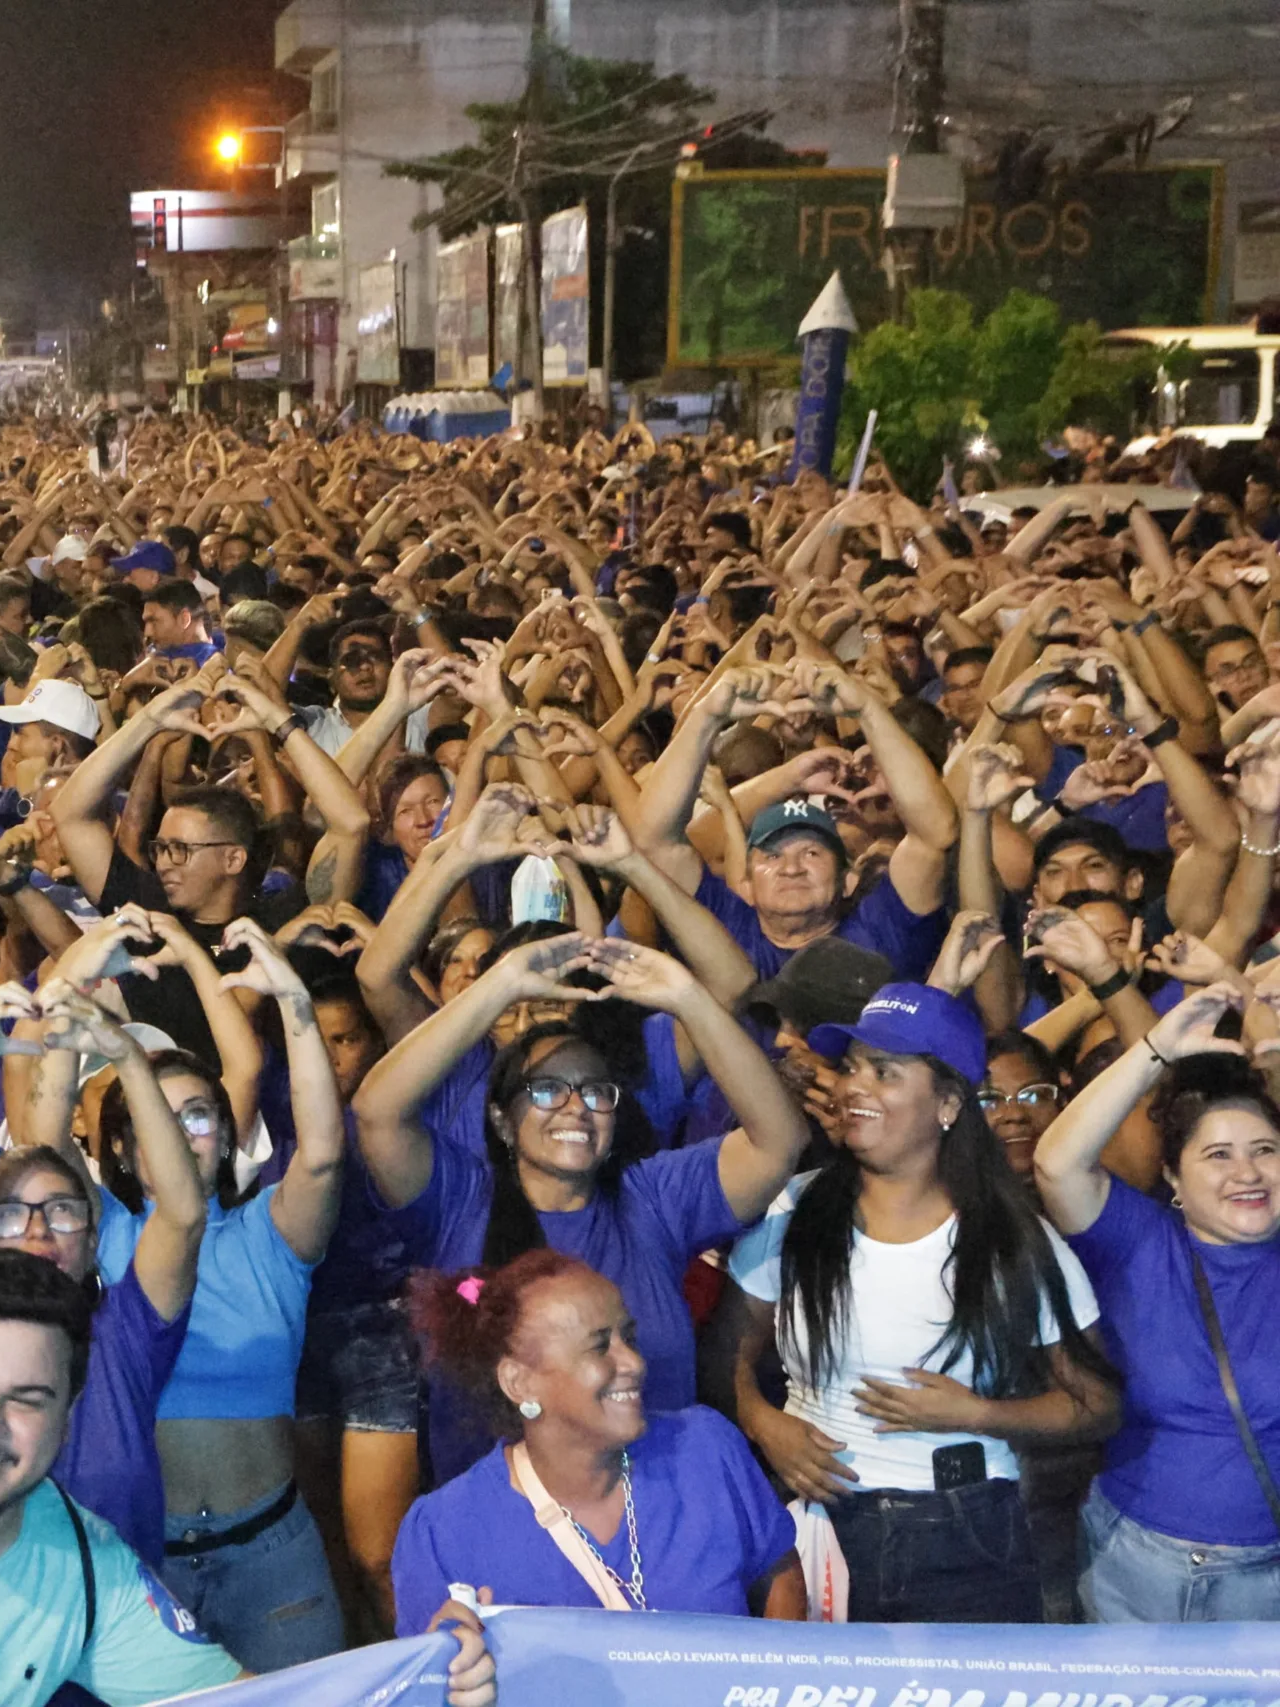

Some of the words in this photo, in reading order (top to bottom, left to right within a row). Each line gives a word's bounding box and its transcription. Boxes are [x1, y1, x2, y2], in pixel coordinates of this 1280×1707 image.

[608, 1649, 681, 1664] COLIGAÇÃO
[684, 1651, 739, 1663] LEVANTA
[741, 1650, 784, 1664] BELÉM
[855, 1656, 963, 1671] PROGRESSISTAS,
[965, 1658, 1006, 1671] UNIÃO
[1008, 1661, 1058, 1673] BRASIL,
[1061, 1662, 1141, 1676] FEDERAÇÃO
